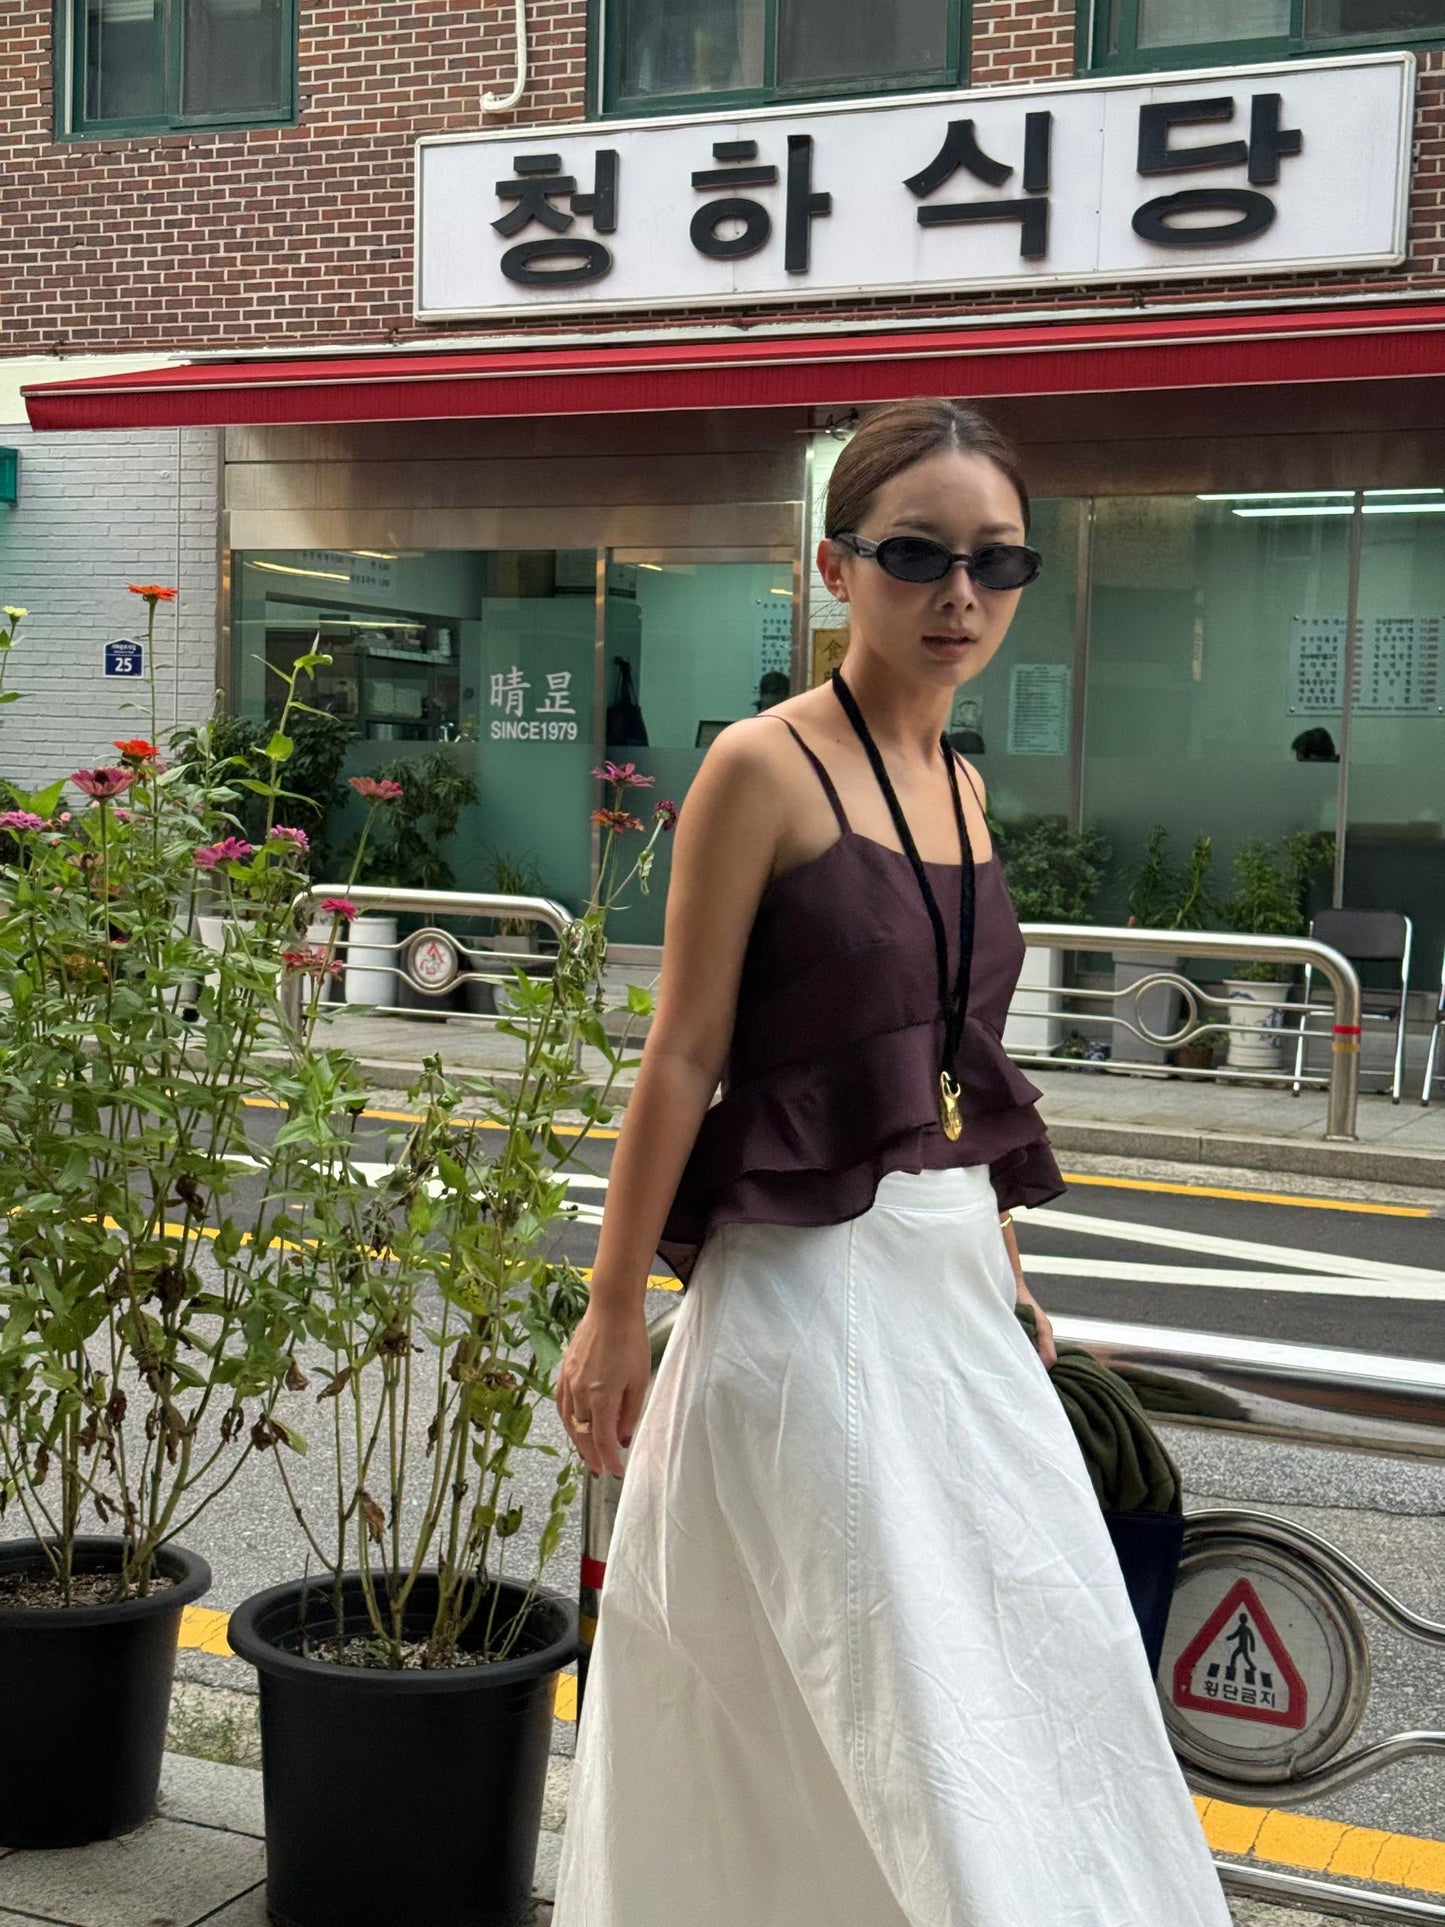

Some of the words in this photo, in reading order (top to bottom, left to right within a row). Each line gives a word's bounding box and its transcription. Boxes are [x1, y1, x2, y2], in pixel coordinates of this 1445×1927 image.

[491, 94, 1302, 284] 청하식당
[115, 657, 132, 672] 25
[490, 721, 578, 741] SINCE1979
[1204, 1680, 1275, 1708] 횡단금지
